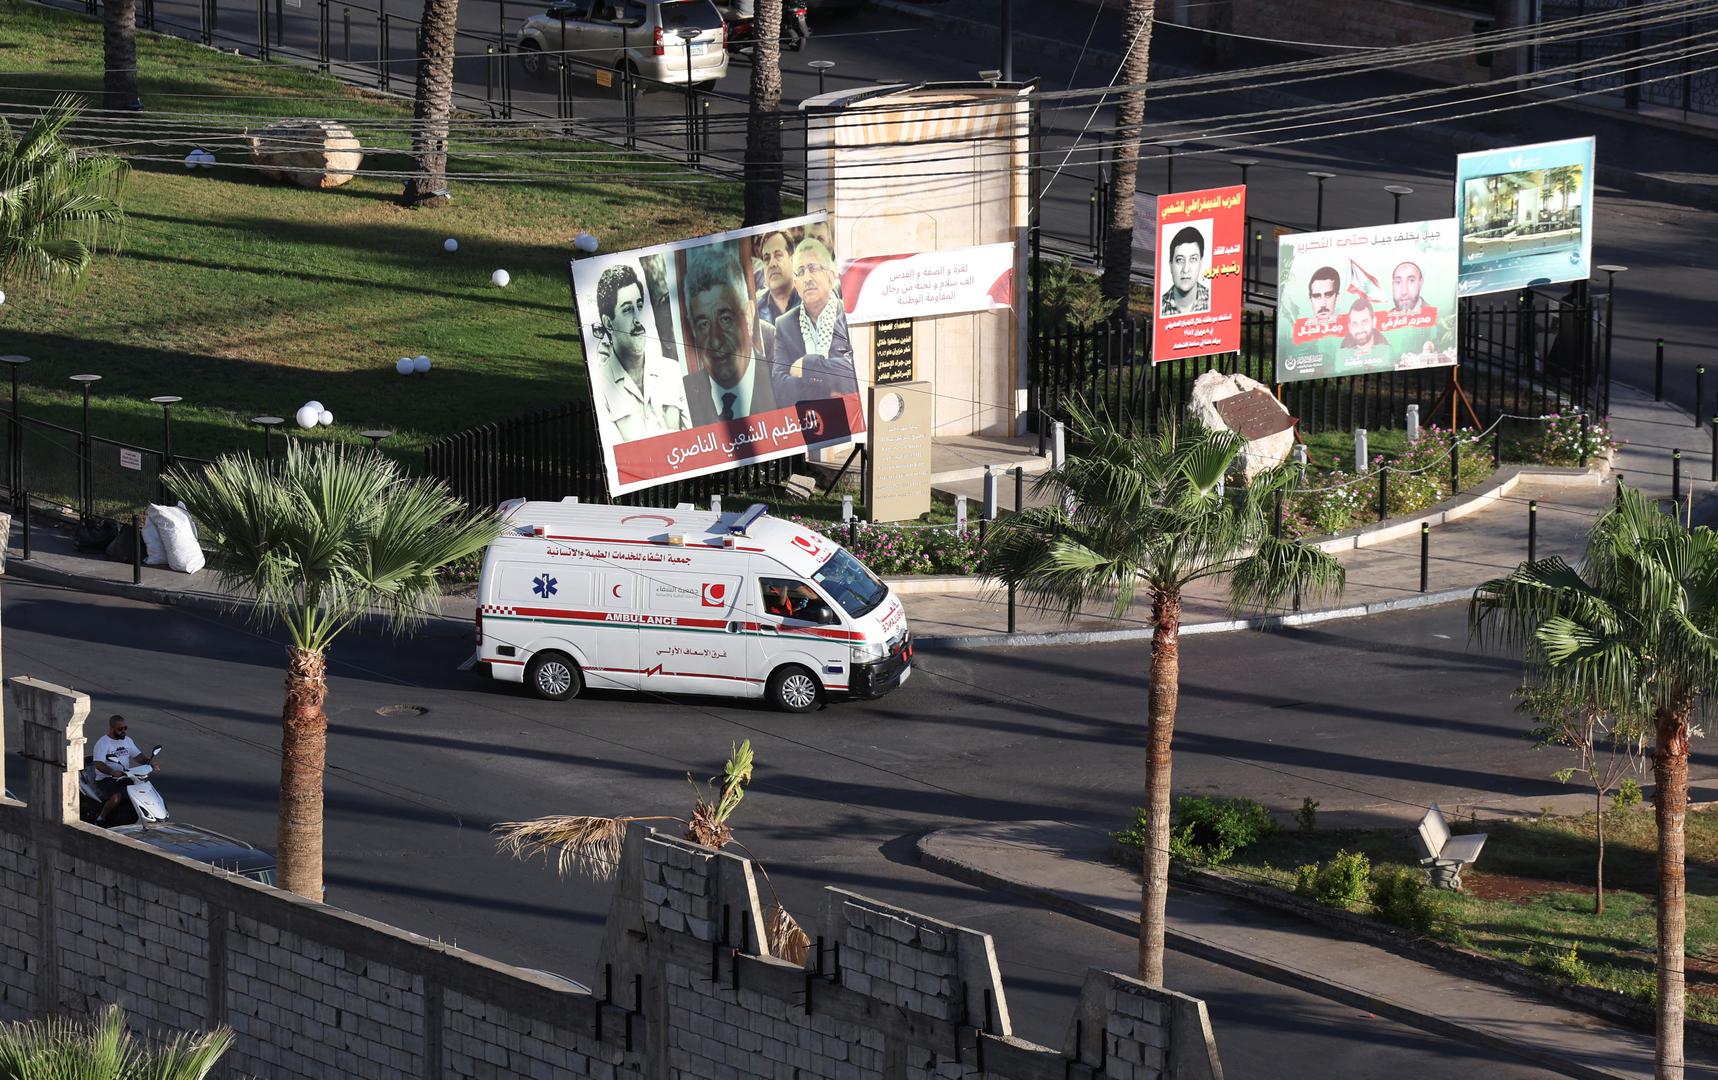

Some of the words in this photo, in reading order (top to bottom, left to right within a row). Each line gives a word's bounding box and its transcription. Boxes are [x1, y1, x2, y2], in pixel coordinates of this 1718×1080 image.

[1161, 200, 1184, 220] الشعبي
[1337, 235, 1369, 247] حتى
[1371, 235, 1391, 246] جيل
[1394, 232, 1419, 242] يخلف
[1422, 231, 1441, 240] جيل
[1297, 237, 1333, 254] التحرير
[890, 269, 915, 282] القدس
[916, 271, 921, 280] و
[922, 266, 945, 276] الضفة
[947, 268, 951, 276] و
[940, 278, 958, 291] سلام
[897, 294, 924, 306] الوطنية
[925, 291, 956, 303] المقاومة
[771, 410, 818, 446] التنظيم
[722, 421, 769, 458] الشعبي
[666, 432, 718, 470] الناصري
[585, 548, 610, 560] الطبية
[612, 551, 641, 560] للخدمات
[642, 552, 666, 562] الشفاء
[668, 553, 692, 566] جمعية
[605, 613, 678, 625] AMBULANCE
[711, 650, 727, 659] فرق
